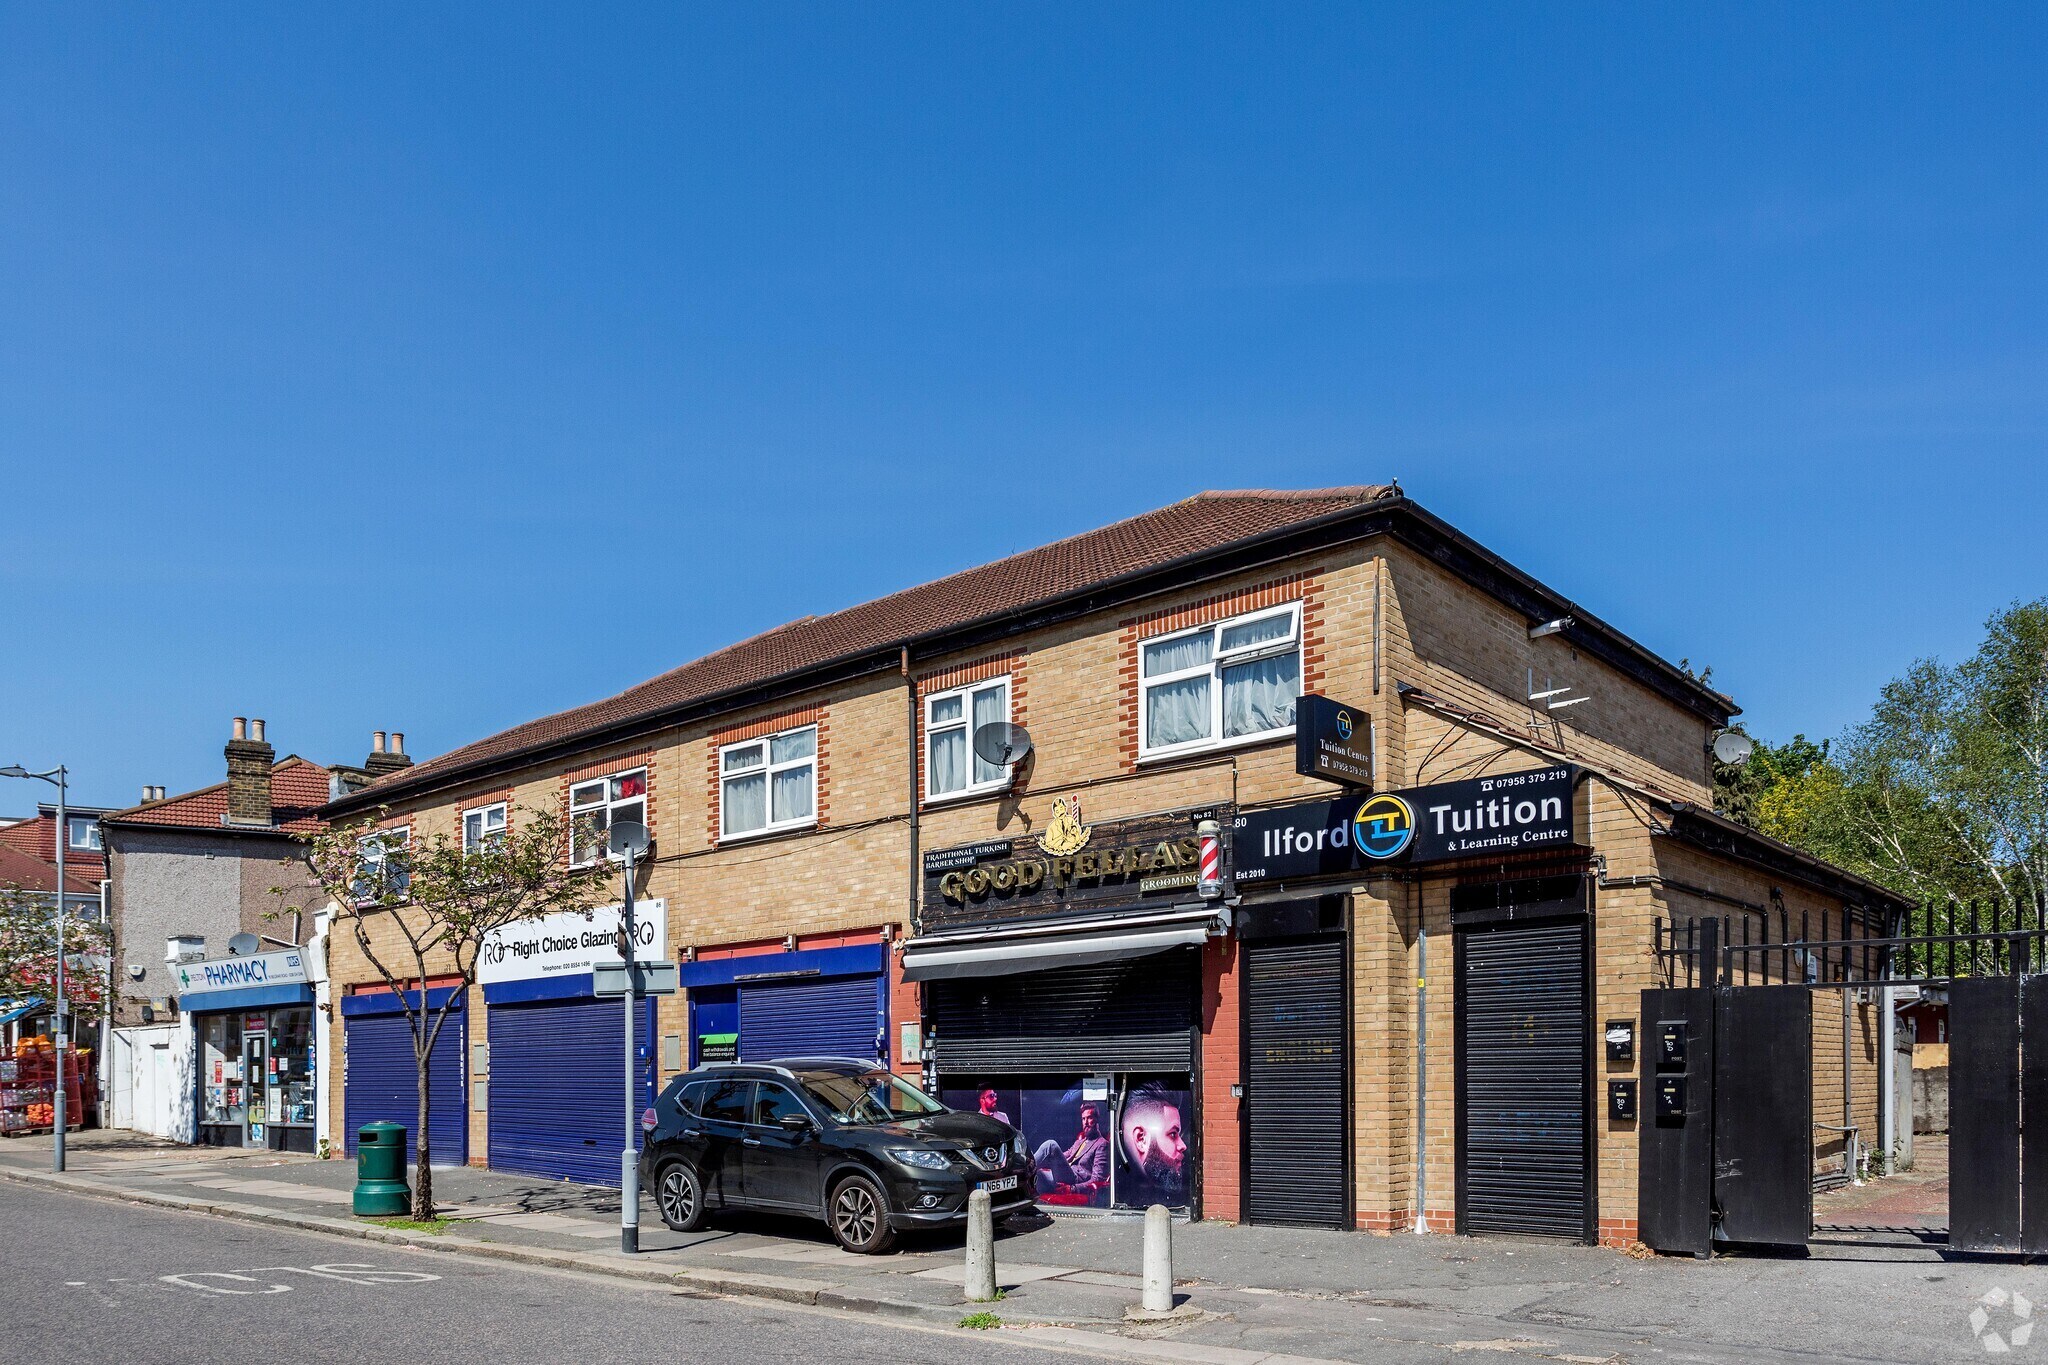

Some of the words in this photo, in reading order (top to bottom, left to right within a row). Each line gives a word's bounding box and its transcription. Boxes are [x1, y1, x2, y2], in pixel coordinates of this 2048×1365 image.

[1319, 738, 1346, 756] Tuition
[1347, 746, 1369, 763] Centre
[1358, 767, 1368, 777] 219
[1496, 775, 1526, 789] 07958
[1528, 773, 1546, 786] 379
[1549, 770, 1568, 783] 219
[1203, 811, 1212, 819] 82
[1234, 817, 1247, 828] 80
[1263, 819, 1349, 858] Ilford
[1429, 794, 1563, 836] Tuition
[1447, 840, 1458, 852] &
[1460, 832, 1519, 852] Learning
[1522, 827, 1569, 843] Centre
[925, 848, 974, 862] TRADITIONAL
[973, 842, 1008, 854] TURKISH
[925, 858, 954, 870] BARBER
[954, 856, 975, 866] SHOP
[939, 861, 1044, 901] GOOD
[1052, 837, 1199, 888] FELLAS
[1141, 874, 1200, 891] GROOMING
[1236, 870, 1248, 880] Est
[1249, 868, 1266, 879] 2010
[513, 939, 540, 960] Right
[542, 934, 578, 954] Choice
[580, 929, 620, 951] Glazing
[204, 959, 269, 986] PHARMACY
[287, 955, 300, 967] NHS
[541, 964, 563, 973] Telephone:
[1002, 1177, 1016, 1189] YPZ
